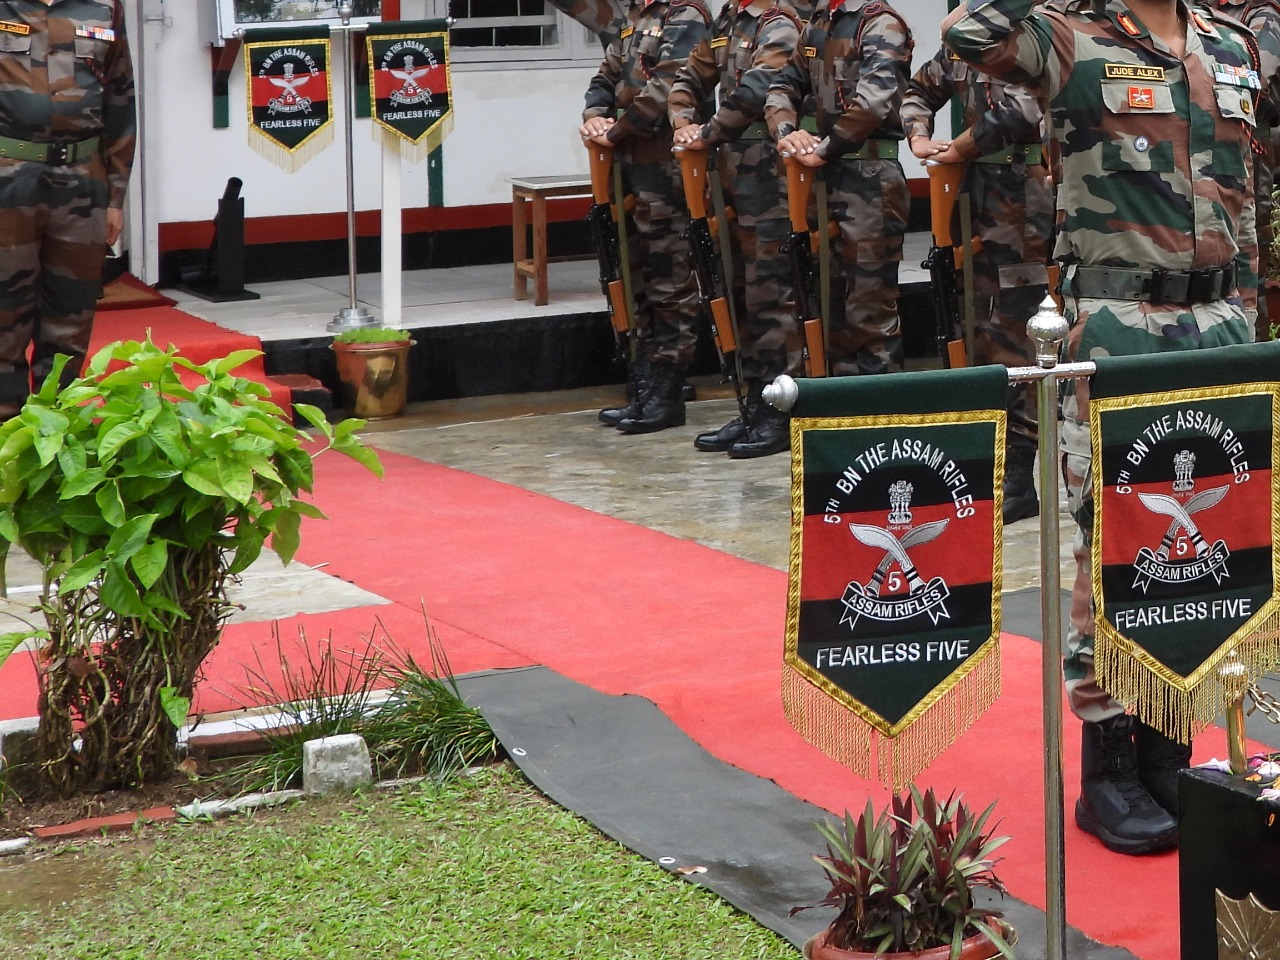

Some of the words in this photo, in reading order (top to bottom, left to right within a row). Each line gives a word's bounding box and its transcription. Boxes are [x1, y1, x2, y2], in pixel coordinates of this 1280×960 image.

[269, 49, 284, 61] THE
[283, 48, 306, 59] ASSAM
[304, 55, 319, 77] RIFLES
[390, 42, 403, 53] THE
[403, 40, 424, 52] ASSAM
[423, 48, 438, 69] RIFLES
[1137, 69, 1159, 77] ALEX
[260, 120, 302, 129] FEARLESS
[304, 119, 321, 127] FIVE
[383, 111, 423, 121] FEARLESS
[424, 109, 441, 117] FIVE
[1116, 470, 1132, 494] 5TH
[1127, 439, 1149, 466] BN
[1143, 414, 1173, 445] THE
[1176, 409, 1223, 438] ASSAM
[1220, 428, 1250, 484] RIFLES
[824, 498, 841, 524] 5TH
[836, 466, 862, 494] BN
[855, 443, 888, 474] THE
[891, 439, 944, 470] ASSAM
[939, 460, 975, 518] RIFLES
[1176, 536, 1188, 555] 5
[1140, 559, 1180, 580] ASSAM
[1183, 551, 1223, 579] RIFLES
[888, 572, 902, 592] 5
[849, 594, 892, 618] ASSAM
[895, 589, 941, 617] RIFLES
[1115, 601, 1207, 631] FEARLESS
[1212, 599, 1252, 620] FIVE
[816, 642, 921, 669] FEARLESS
[926, 640, 969, 662] FIVE
